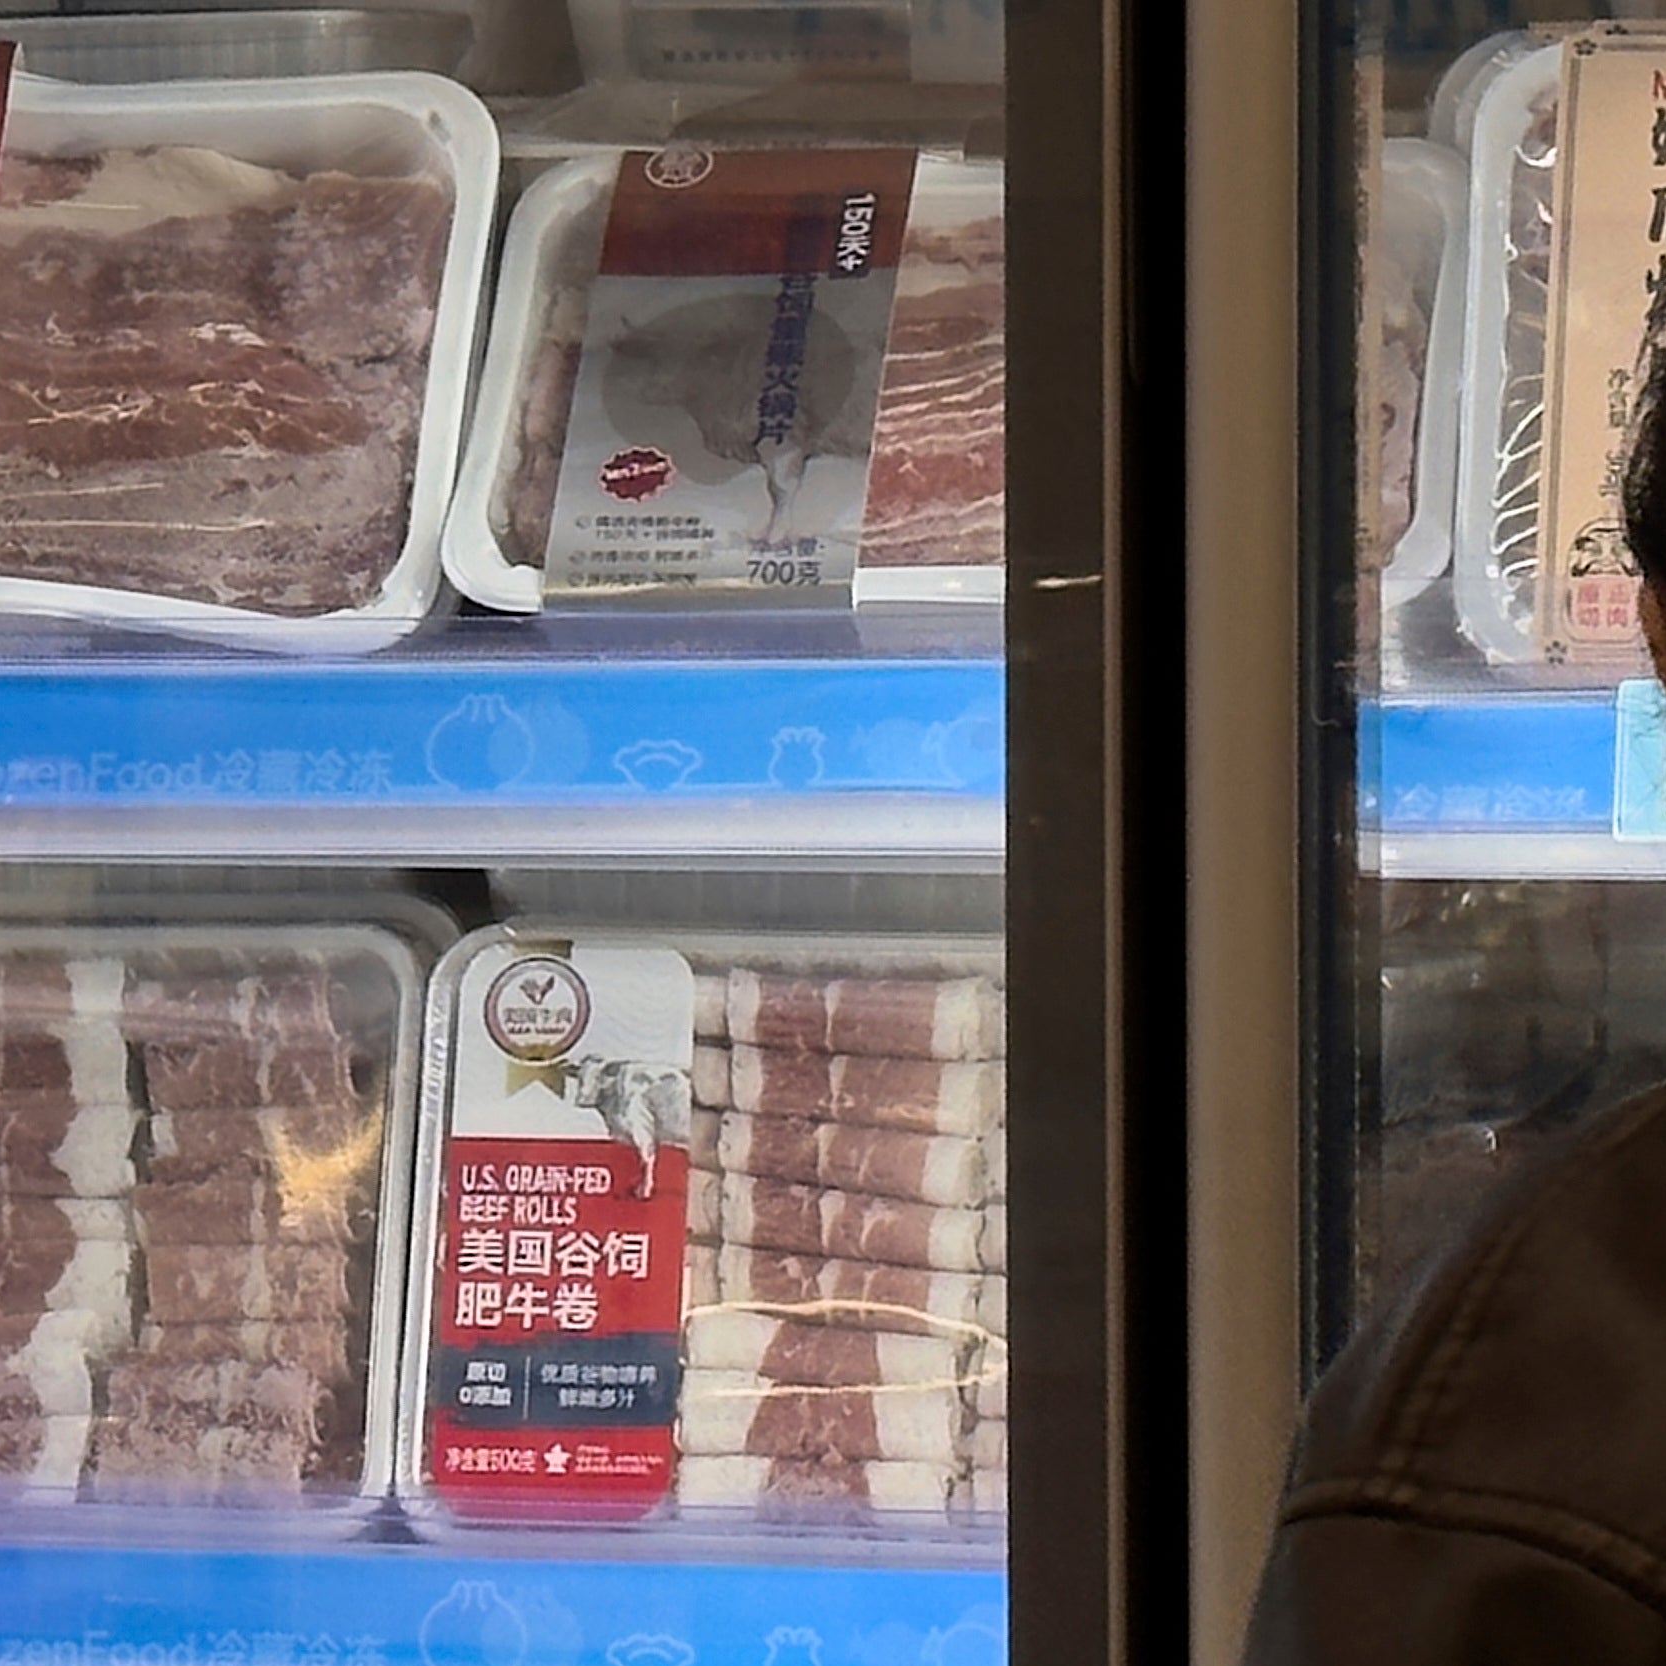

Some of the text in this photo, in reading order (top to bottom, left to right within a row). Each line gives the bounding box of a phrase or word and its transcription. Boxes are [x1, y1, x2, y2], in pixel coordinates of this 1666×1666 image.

[461, 1164, 611, 1195] U.S. GRAIN-FED
[513, 1197, 577, 1225] ROLLS
[457, 1228, 649, 1279] 美国谷饲
[455, 1281, 599, 1330] 肥牛卷
